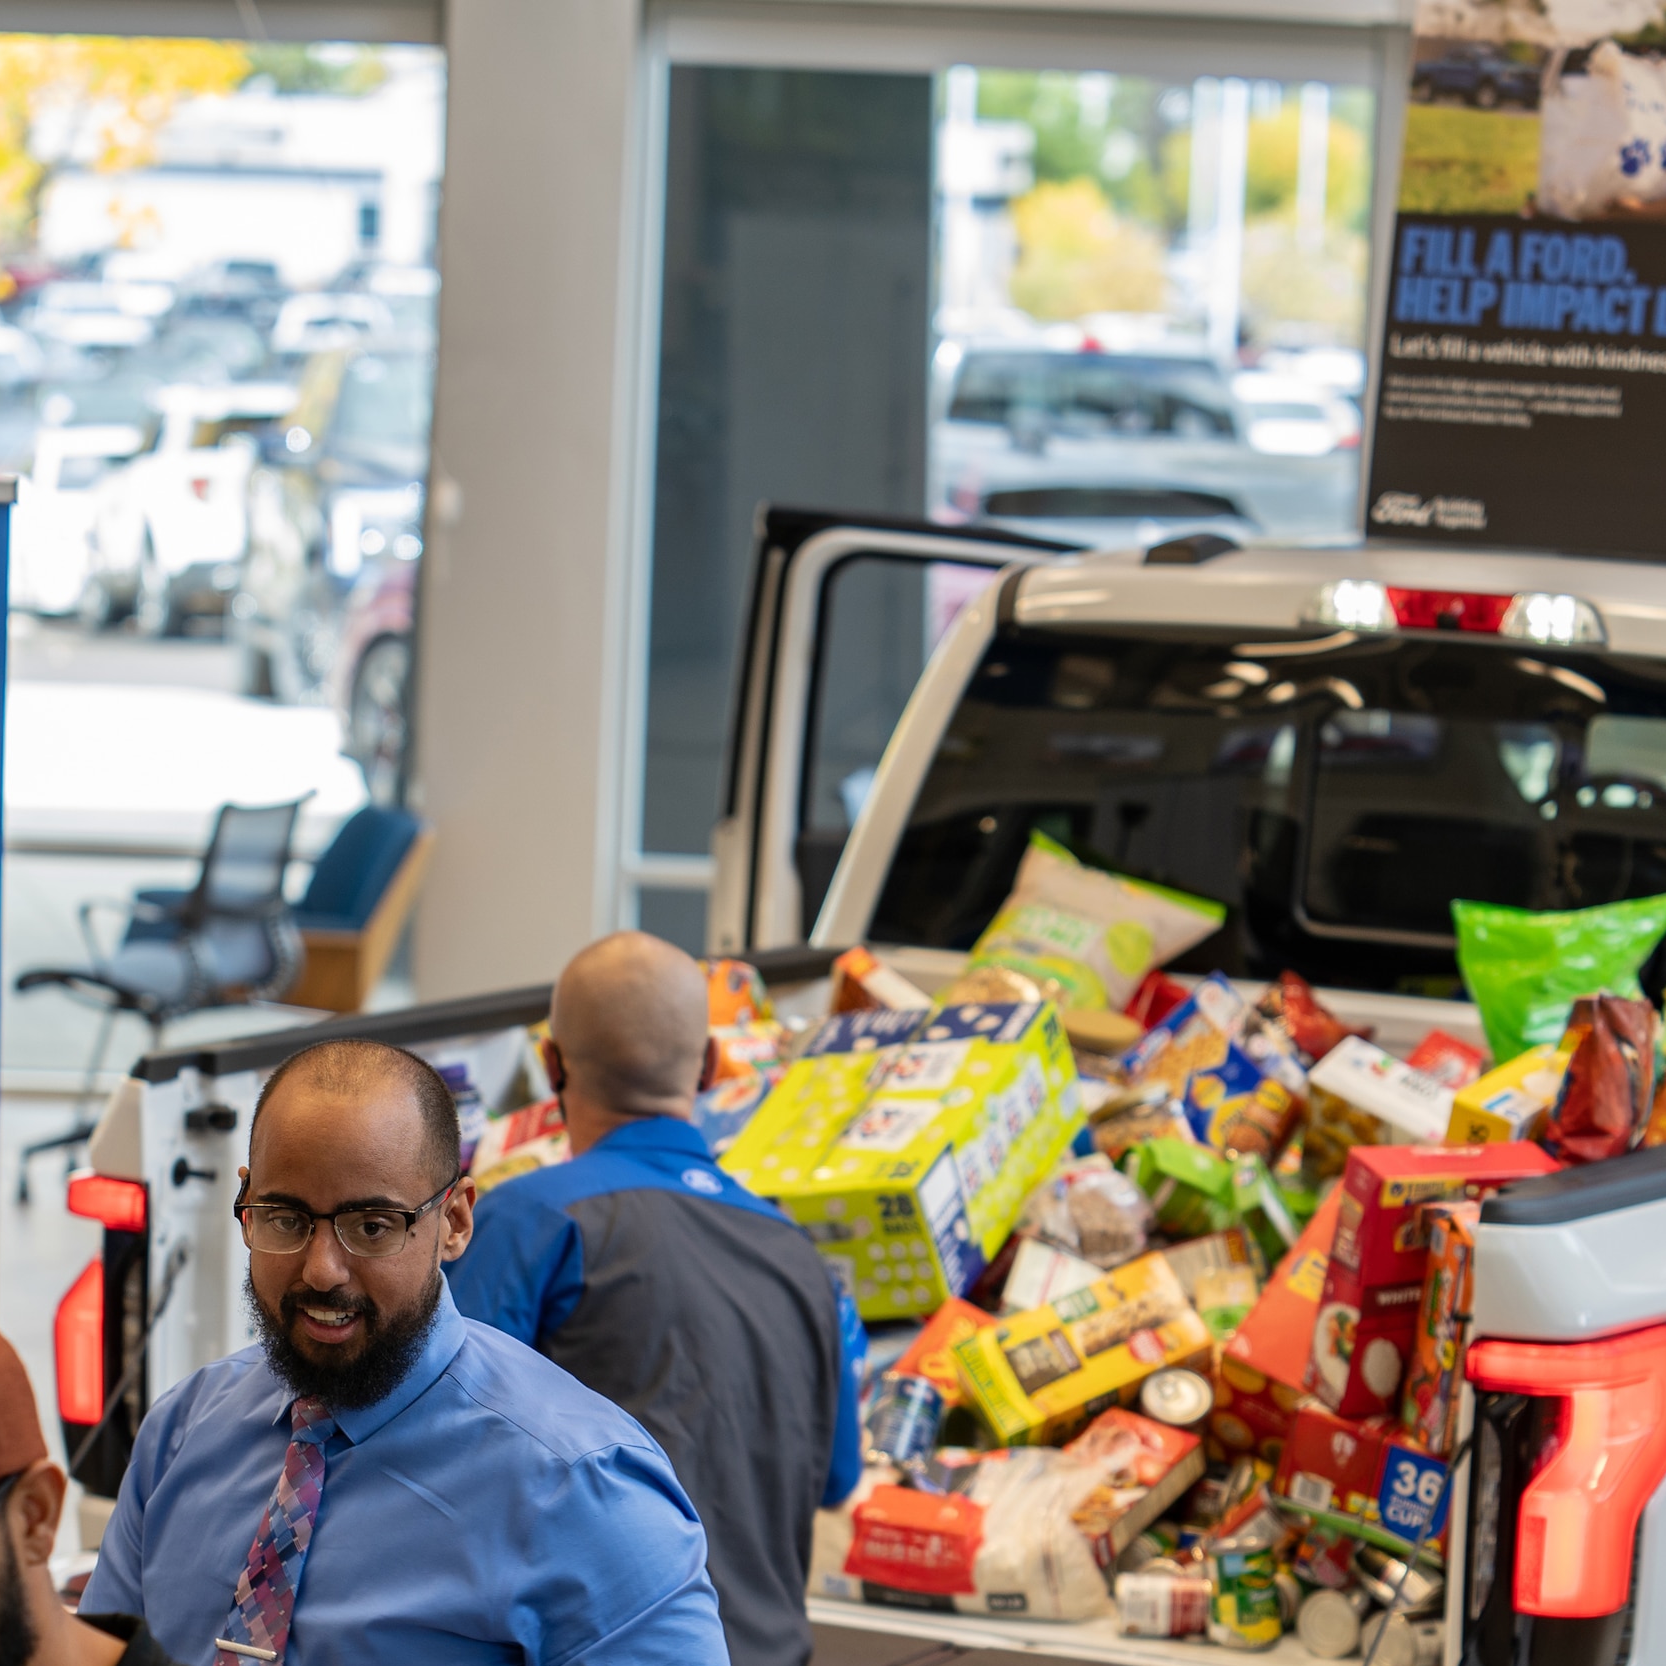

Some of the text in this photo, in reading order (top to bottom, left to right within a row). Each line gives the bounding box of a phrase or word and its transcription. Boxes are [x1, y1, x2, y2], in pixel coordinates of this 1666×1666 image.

[1399, 225, 1637, 286] FILL A FORD.
[1393, 275, 1499, 327] HELP
[1499, 280, 1652, 335] IMPACT
[1483, 339, 1550, 368] vehicle
[1551, 342, 1594, 369] with
[1393, 1460, 1444, 1506] 36
